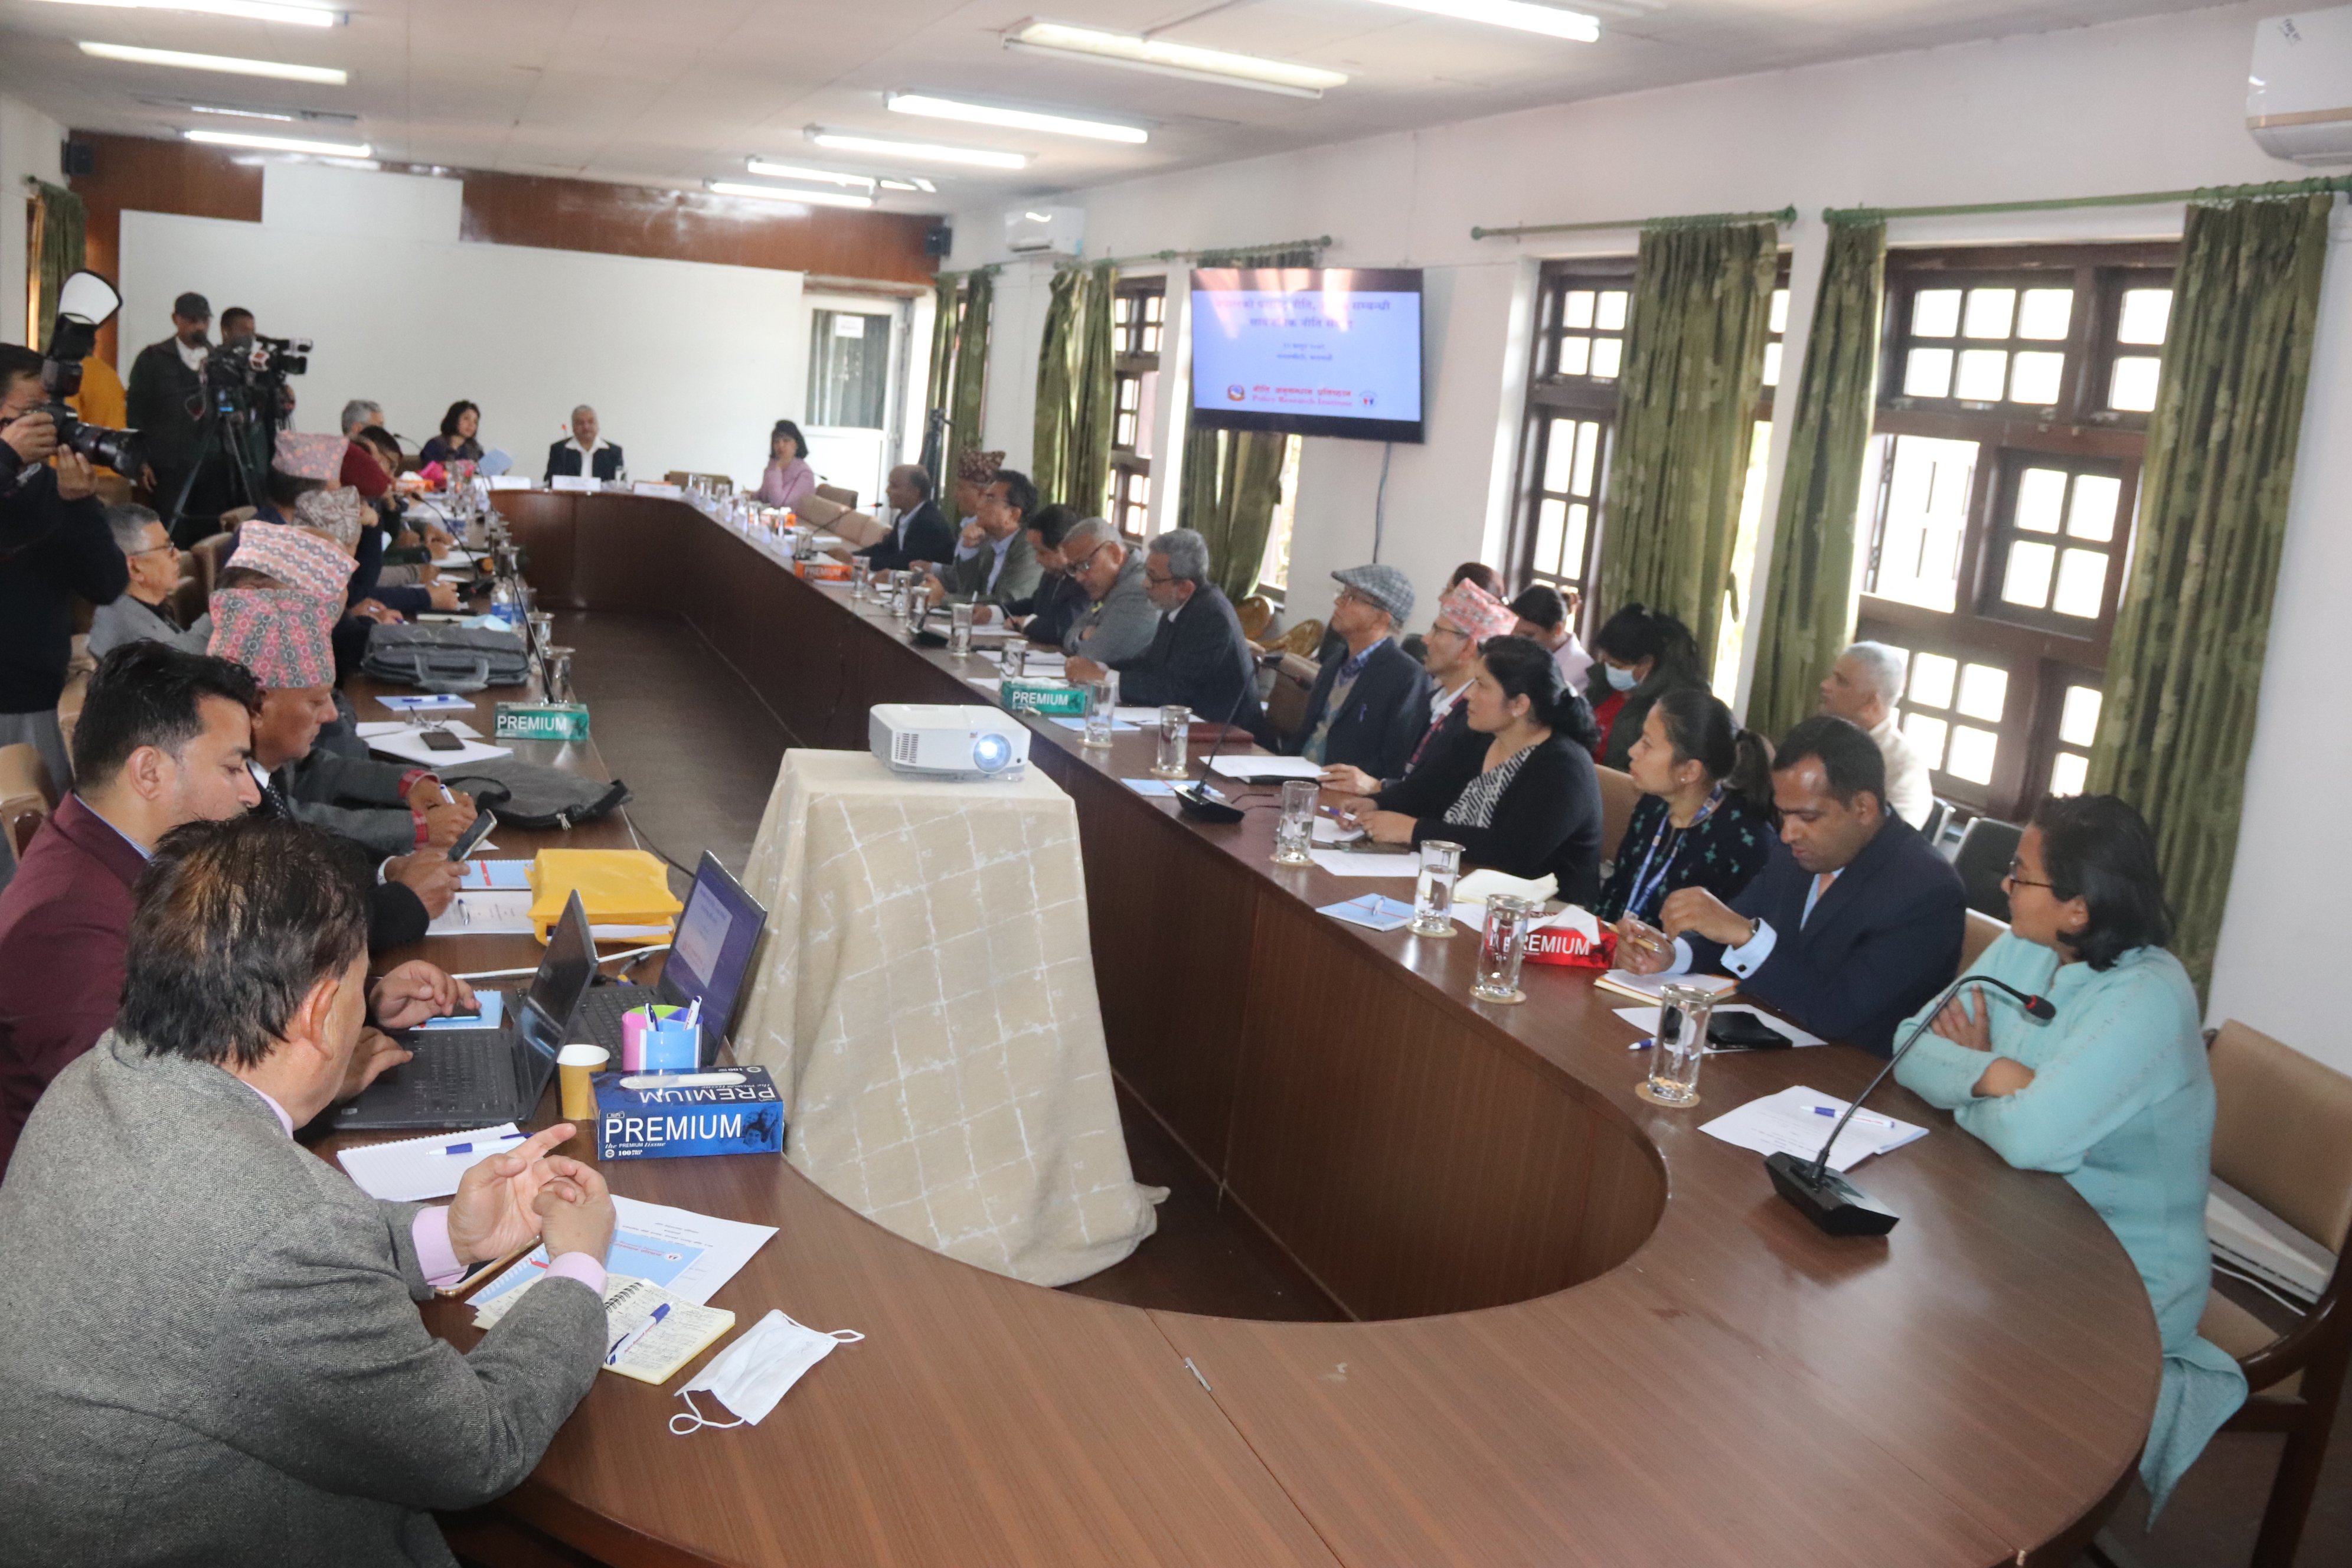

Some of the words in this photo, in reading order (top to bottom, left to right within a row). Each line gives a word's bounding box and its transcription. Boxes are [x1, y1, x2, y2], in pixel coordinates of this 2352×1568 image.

[1012, 691, 1069, 705] PREMIUM
[497, 716, 567, 731] PREMIUM
[1523, 934, 1590, 956] REMIUM
[639, 1087, 776, 1104] PREMIUM
[605, 1114, 741, 1143] PREMIUM
